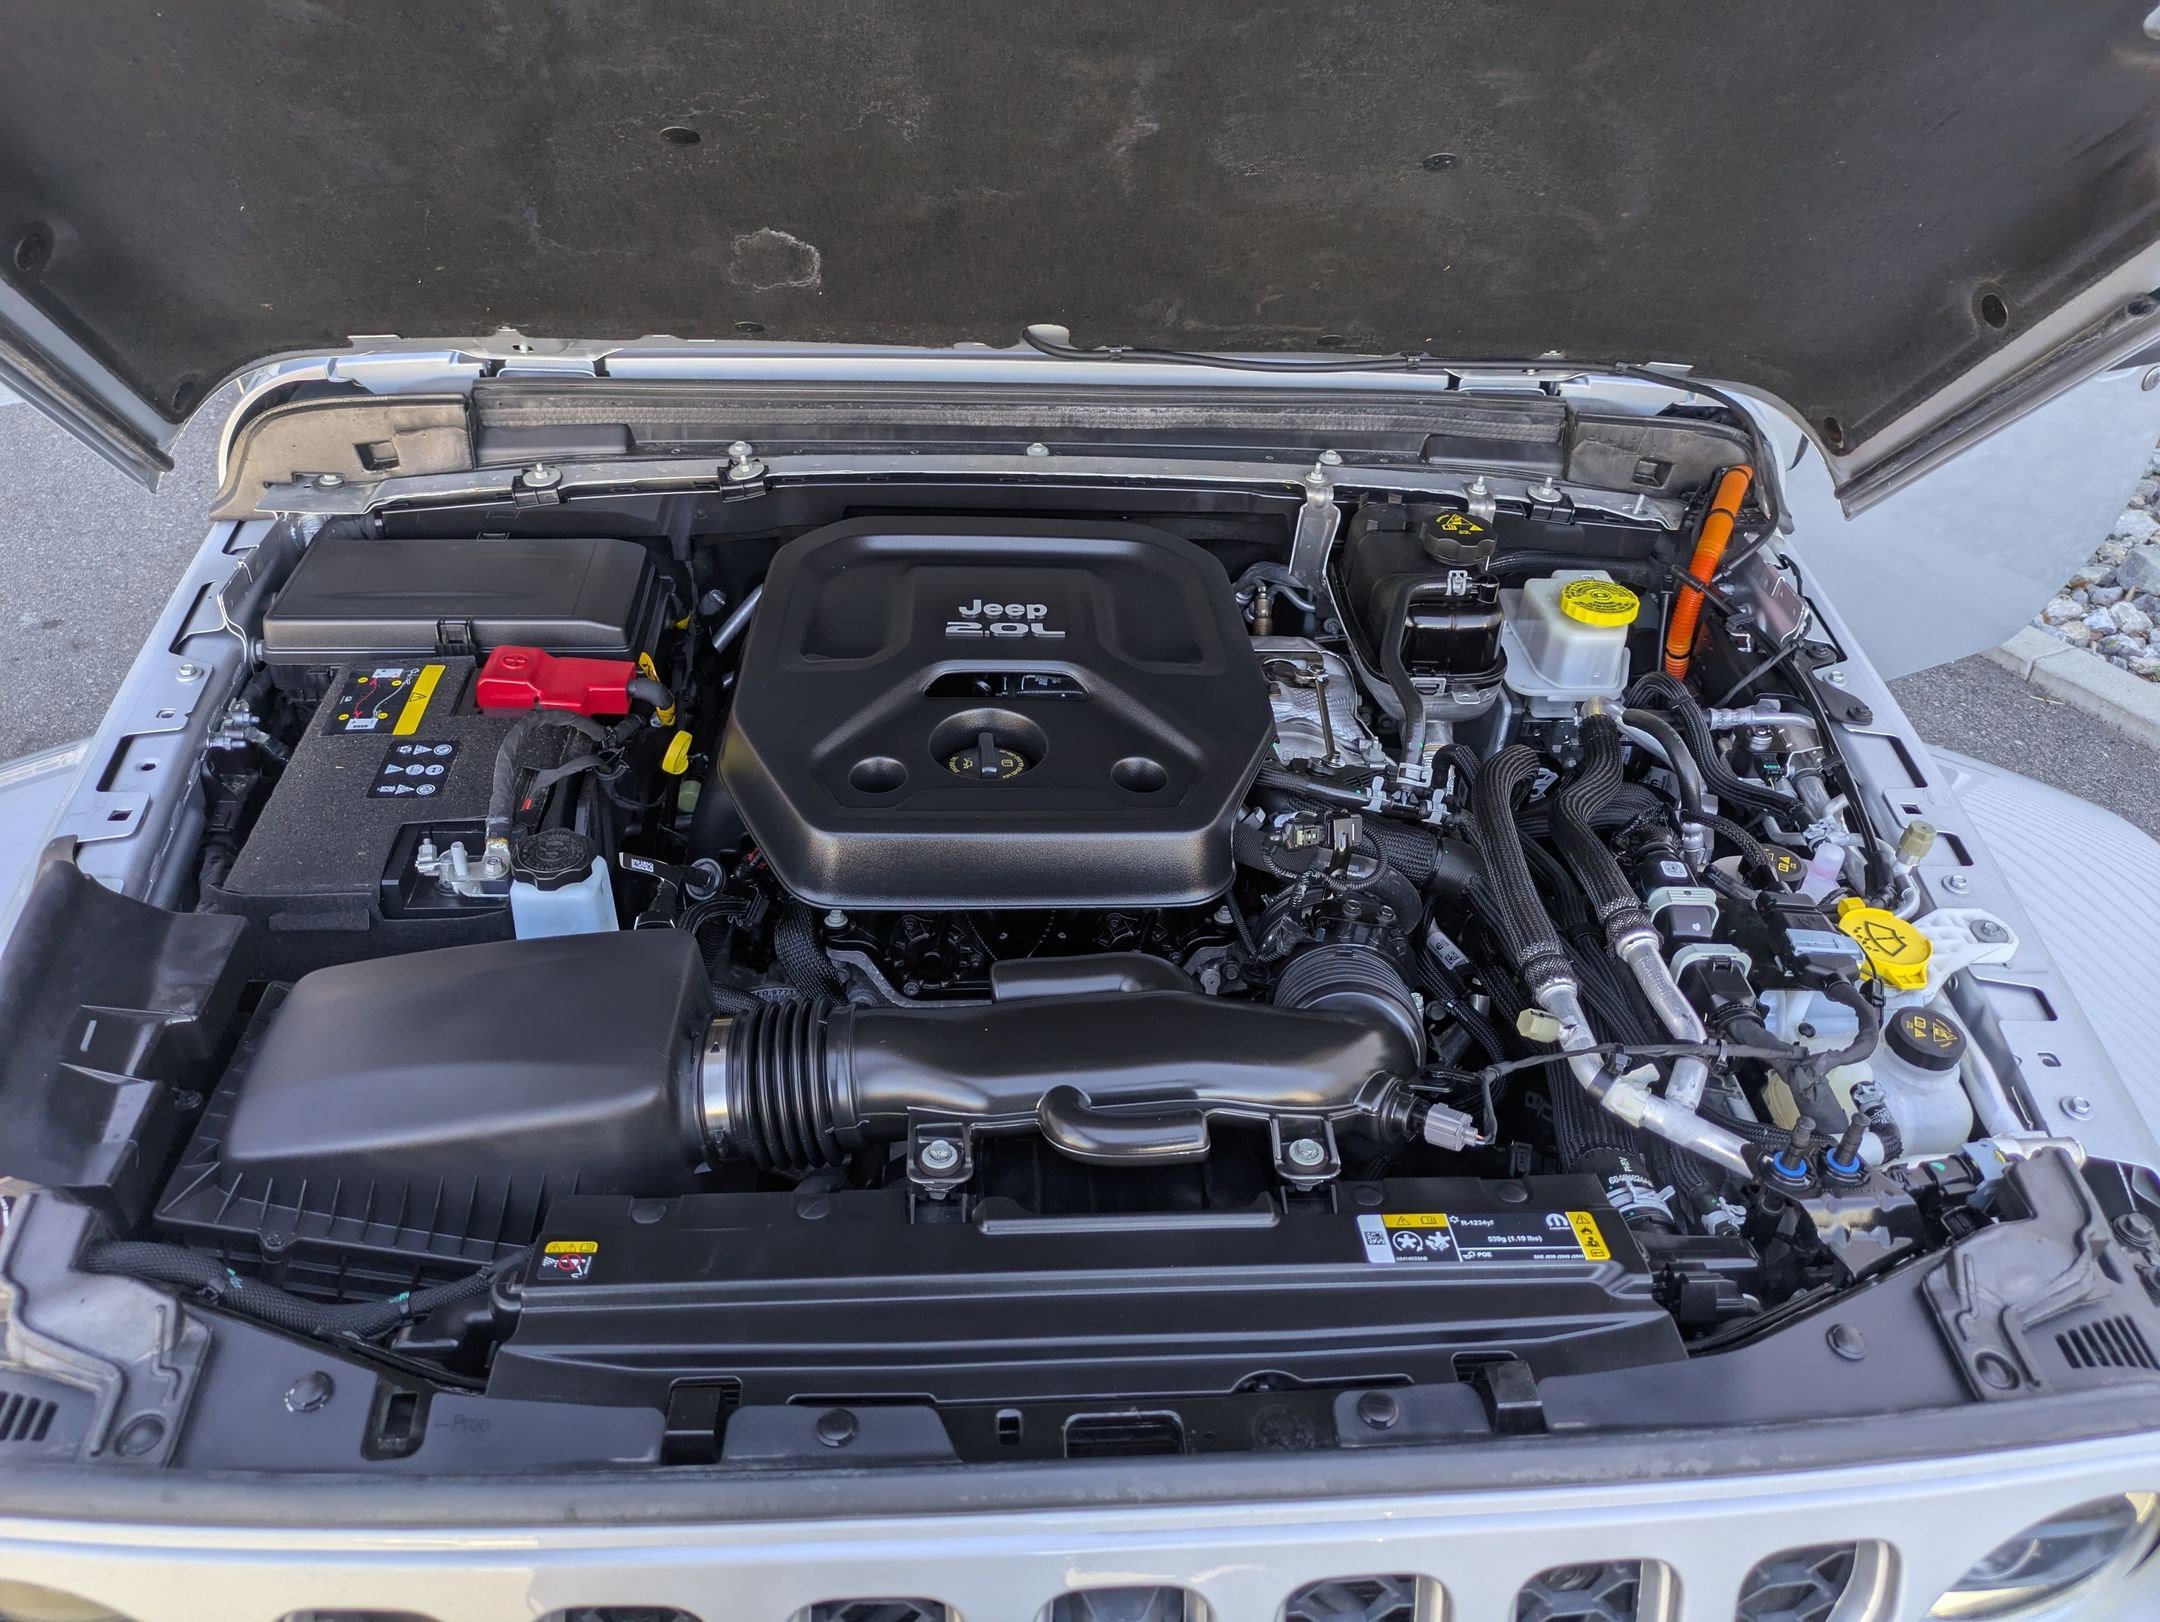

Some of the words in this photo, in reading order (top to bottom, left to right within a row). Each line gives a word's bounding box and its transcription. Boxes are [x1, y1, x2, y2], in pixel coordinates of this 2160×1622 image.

[958, 599, 1048, 620] Jeep
[945, 621, 1066, 638] 2.0L
[1460, 1219, 1494, 1228] R-1234yf
[1526, 1235, 1543, 1243] lbs)
